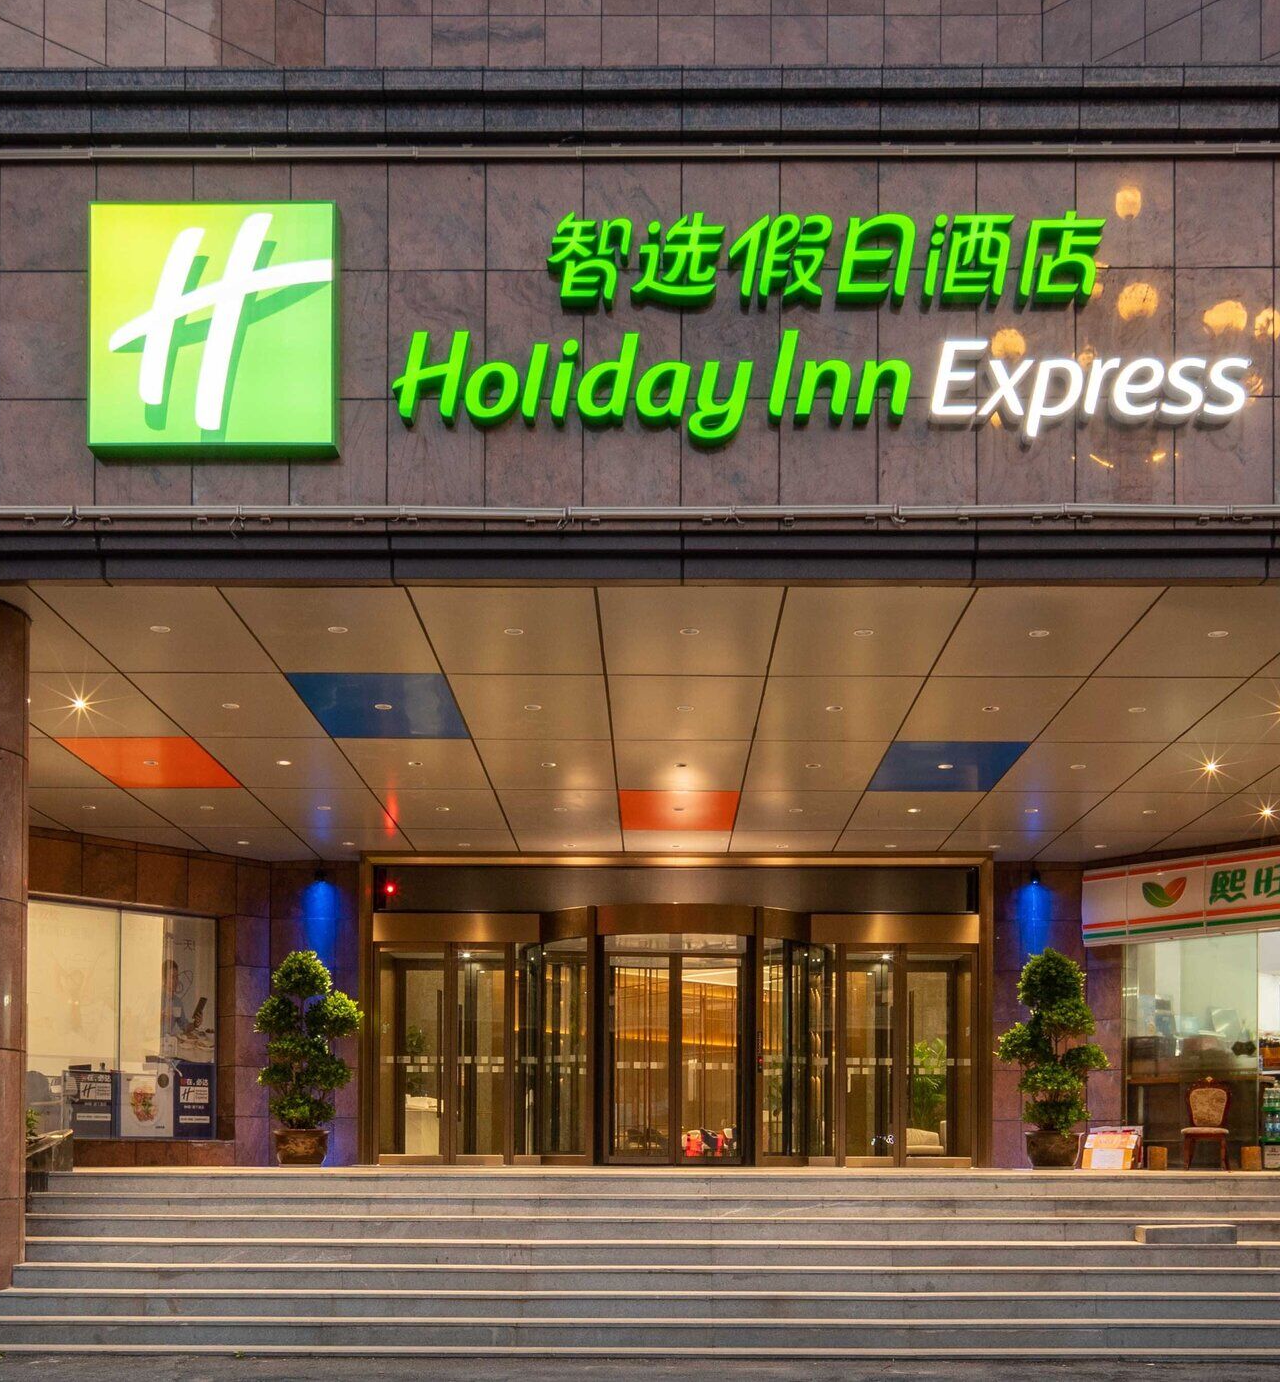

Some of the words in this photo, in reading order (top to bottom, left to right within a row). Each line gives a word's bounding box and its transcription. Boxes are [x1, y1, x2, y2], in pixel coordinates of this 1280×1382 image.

[547, 210, 1108, 305] 智选假日酒店
[391, 327, 754, 442] Holiday
[767, 328, 913, 421] Inn
[929, 337, 1255, 439] Express
